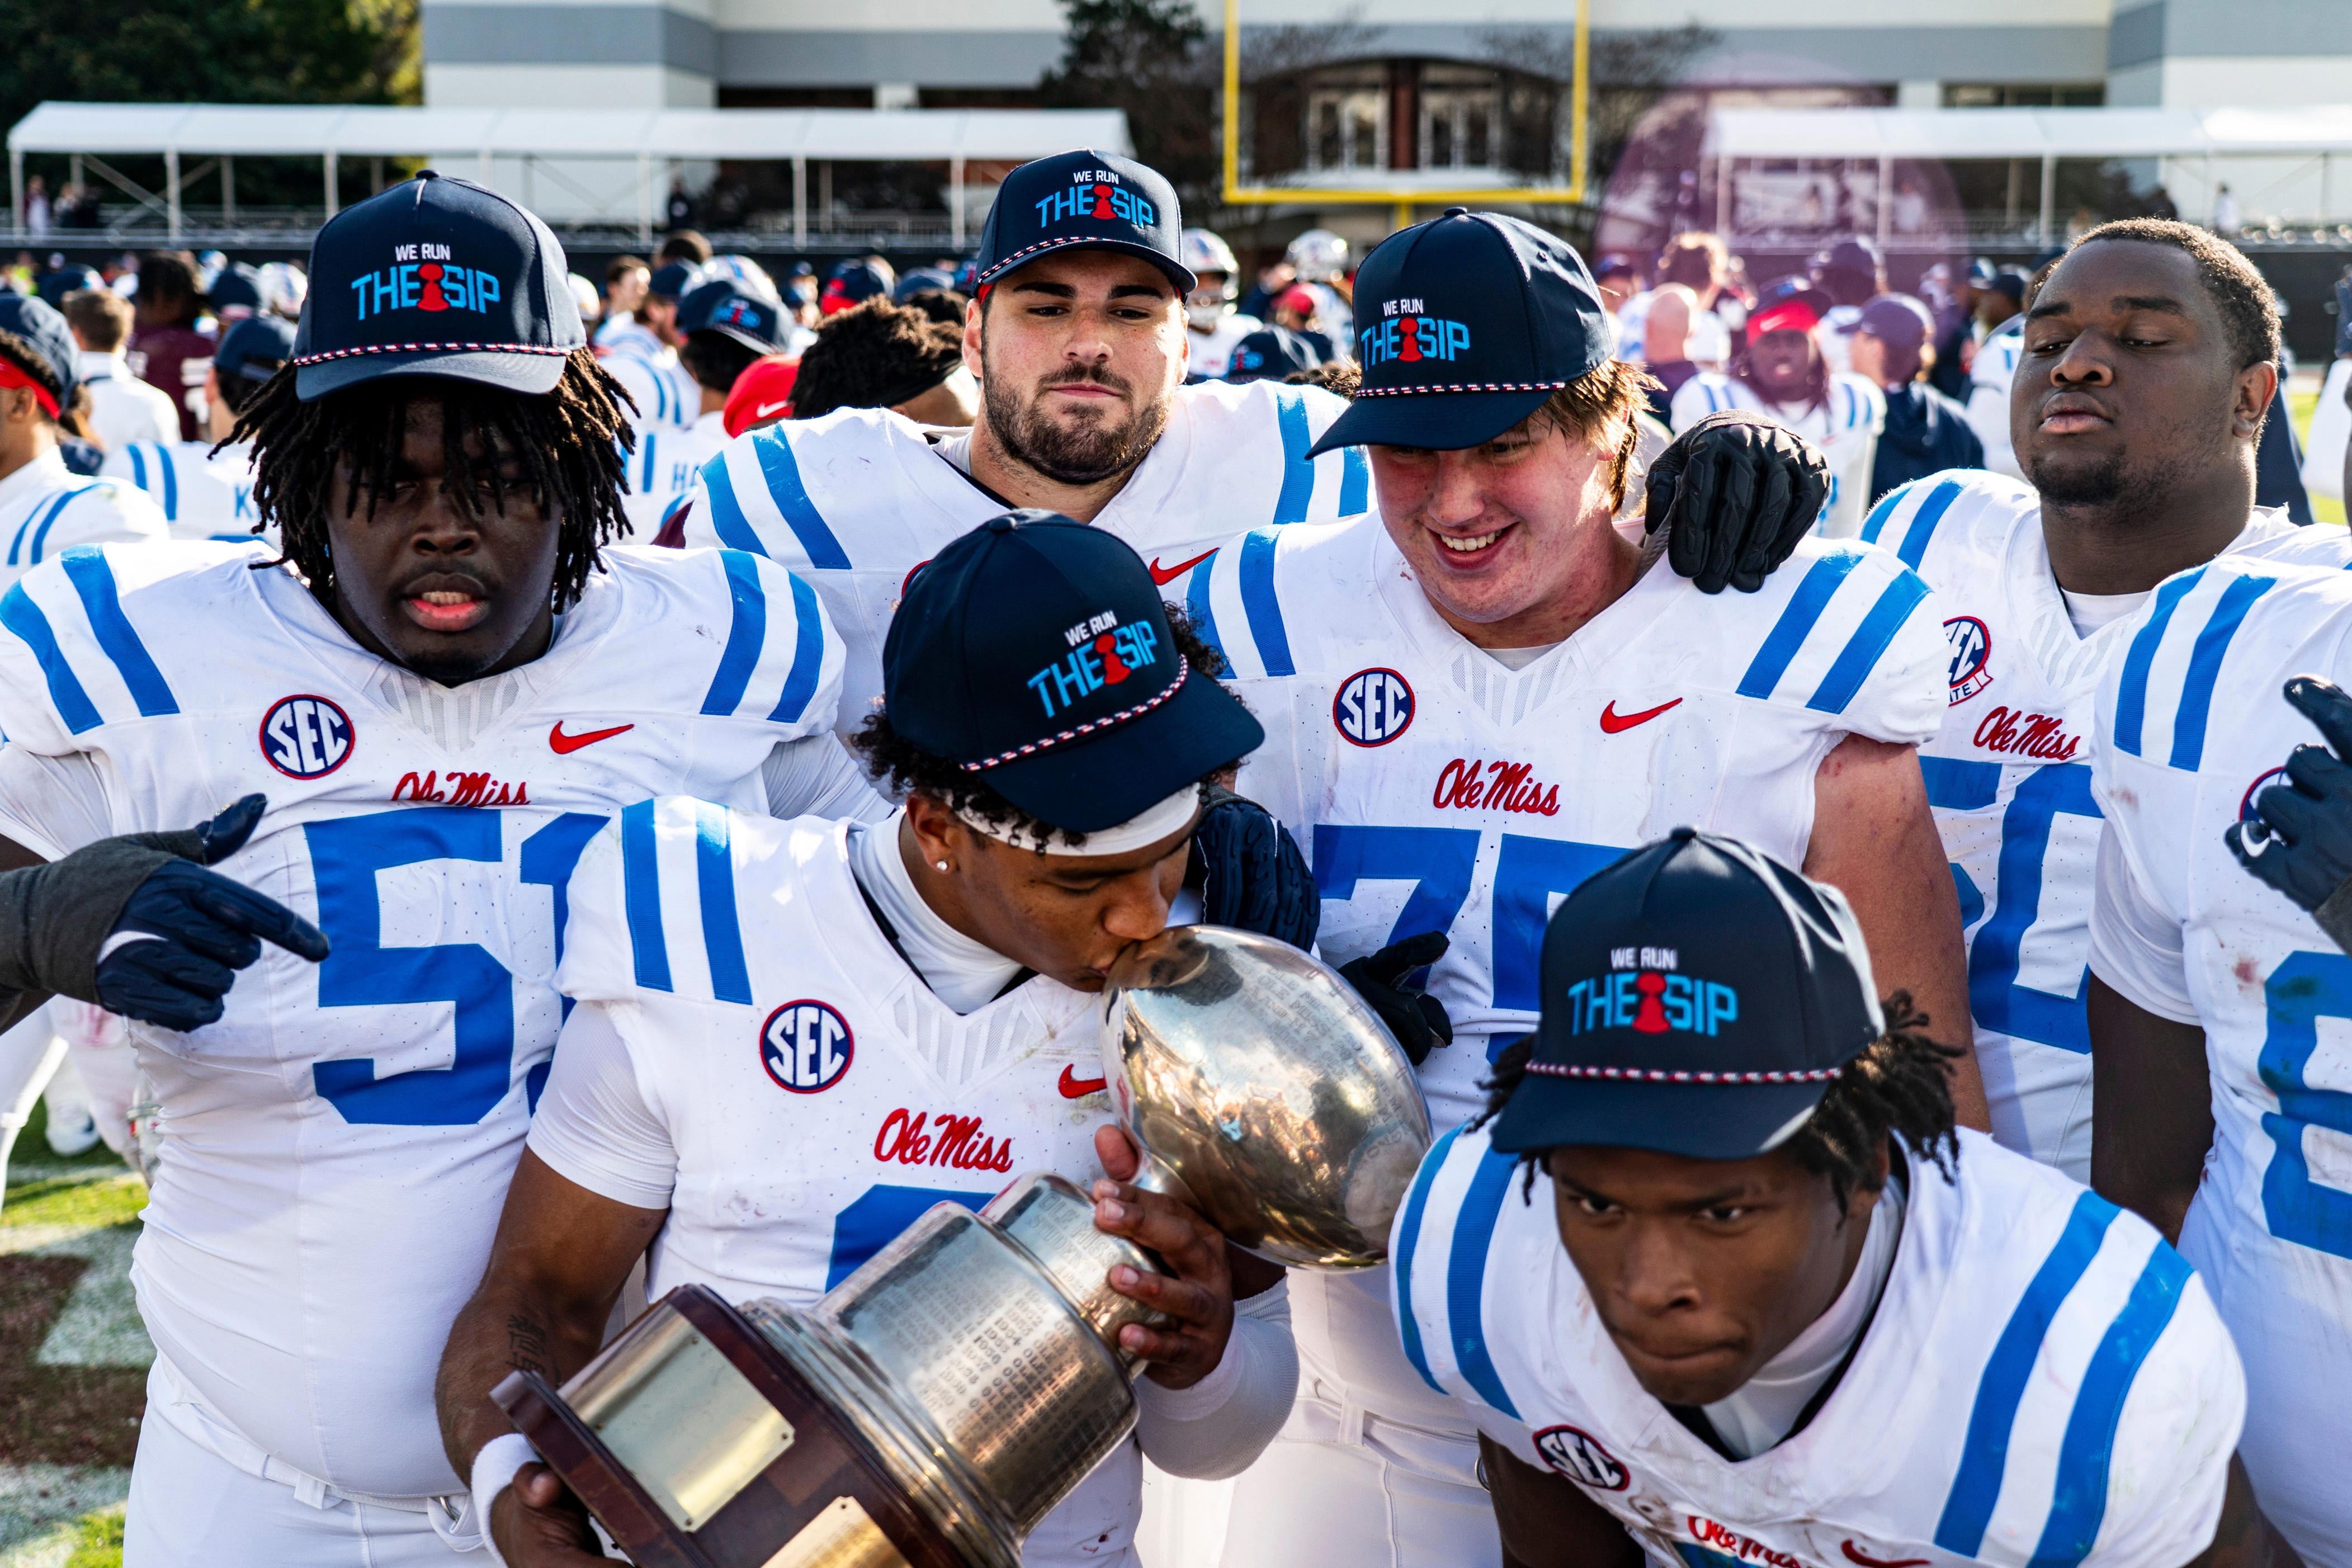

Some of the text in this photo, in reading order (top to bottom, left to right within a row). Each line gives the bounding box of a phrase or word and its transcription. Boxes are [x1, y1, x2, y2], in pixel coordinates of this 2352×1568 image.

[1074, 170, 1119, 185] WE RUN
[1036, 185, 1154, 229] THE SIP
[395, 242, 451, 261] WE RUN
[351, 265, 501, 321] THE SIP
[1383, 298, 1424, 317] WE RUN
[1361, 318, 1470, 371] THE SIP
[1064, 610, 1117, 647] WE RUN
[1027, 620, 1158, 718] THE SIP
[1341, 675, 1407, 742] SEC
[1973, 706, 2081, 761] Ole Miss
[267, 700, 349, 774] SEC
[445, 772, 532, 807] Miss
[1433, 758, 1561, 816] Ole Miss
[1610, 947, 1678, 971] WE RUN
[1568, 972, 1739, 1037] THE SIP
[767, 1005, 846, 1087] SEC
[873, 1108, 1014, 1173] Ole Miss
[1539, 1431, 1622, 1487] SEC
